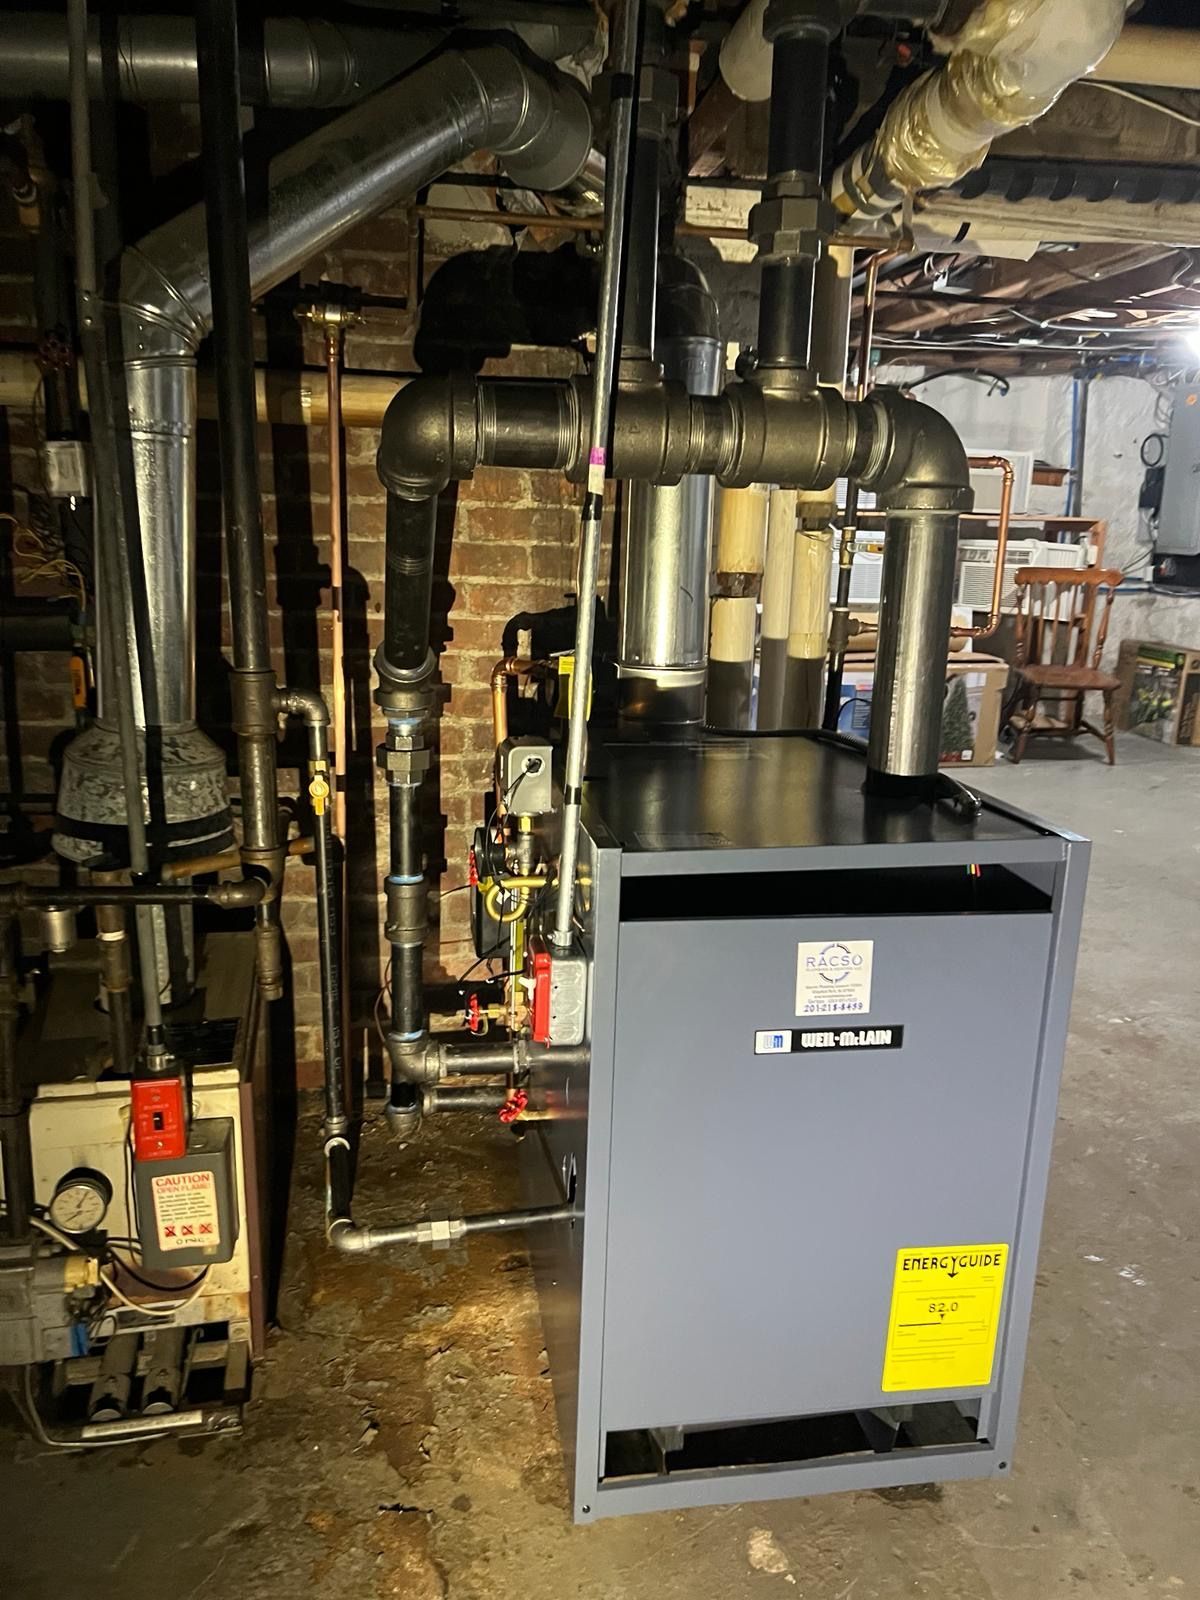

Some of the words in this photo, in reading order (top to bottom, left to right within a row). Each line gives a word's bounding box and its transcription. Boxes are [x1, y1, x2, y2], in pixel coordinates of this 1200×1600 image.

[805, 954, 863, 967] RACSO
[156, 1174, 210, 1187] CAUTION
[928, 1302, 958, 1313] 82.0
